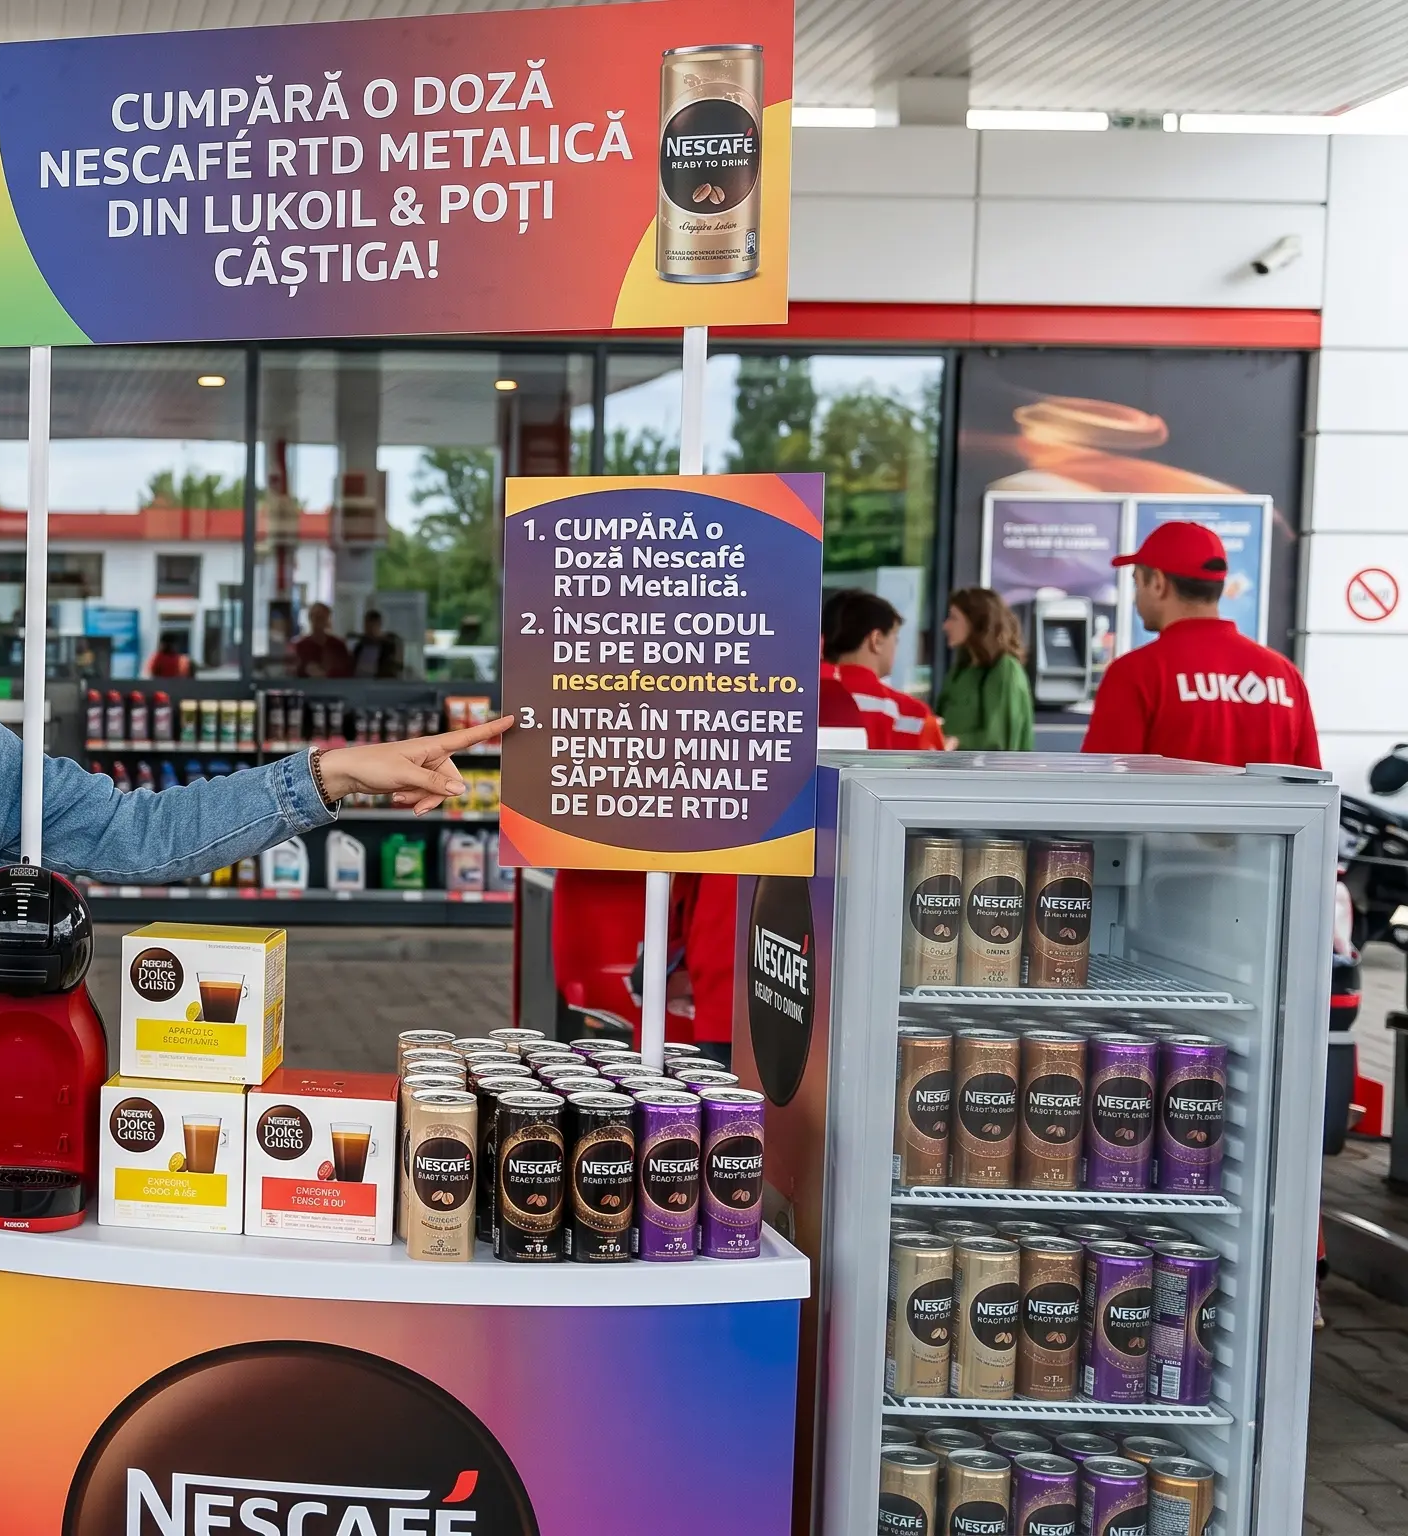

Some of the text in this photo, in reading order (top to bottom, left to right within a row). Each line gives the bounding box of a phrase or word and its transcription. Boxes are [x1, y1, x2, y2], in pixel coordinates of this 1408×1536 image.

[111, 58, 554, 133] CUMPĂRĂ O DOZĂ
[40, 109, 634, 189] NESCAFÉ RTD METALICĂ
[705, 160, 718, 168] TO
[108, 180, 554, 239] DIN LUKOIL & POȚI
[213, 236, 440, 299] CÂȘTIGA!
[522, 518, 546, 541] 1.
[554, 511, 699, 541] CUMPĂRĂ
[554, 543, 745, 569] Doză Nescafé
[554, 573, 747, 597] RTD Metalică.
[520, 606, 775, 636] 2. ÎNSCRIE CODUL
[553, 641, 750, 665] DE PE BON PE
[551, 669, 805, 694] nescafecontest.ro.
[519, 702, 804, 733] 3. INTRĂ ÎN TRAGERE
[551, 736, 792, 762] PENTRU MINI ME
[551, 759, 768, 791] SĂPTĂMÂNALE
[551, 793, 749, 821] DE DOZE RTD!
[879, 1508, 923, 1528] ESCAFÉ
